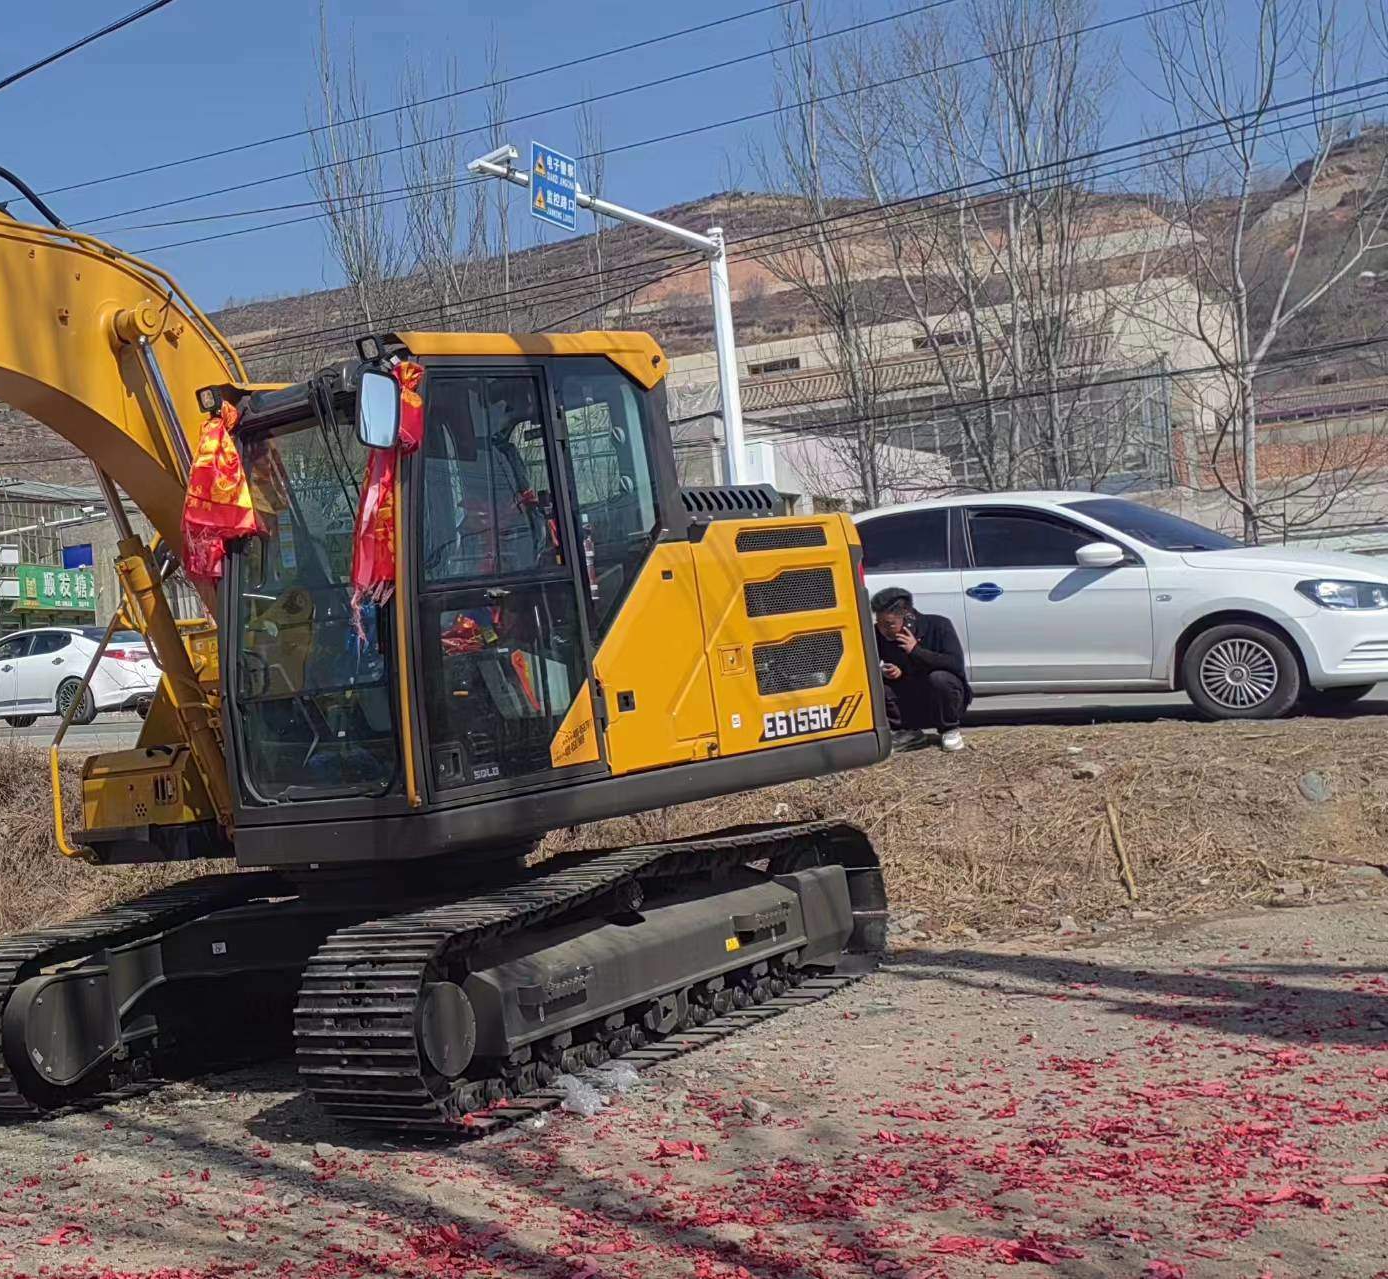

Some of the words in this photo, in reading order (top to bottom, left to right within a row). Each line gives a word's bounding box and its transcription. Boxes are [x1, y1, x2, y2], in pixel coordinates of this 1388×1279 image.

[43, 571, 94, 599] 顺发糖
[763, 704, 832, 738] E6155H
